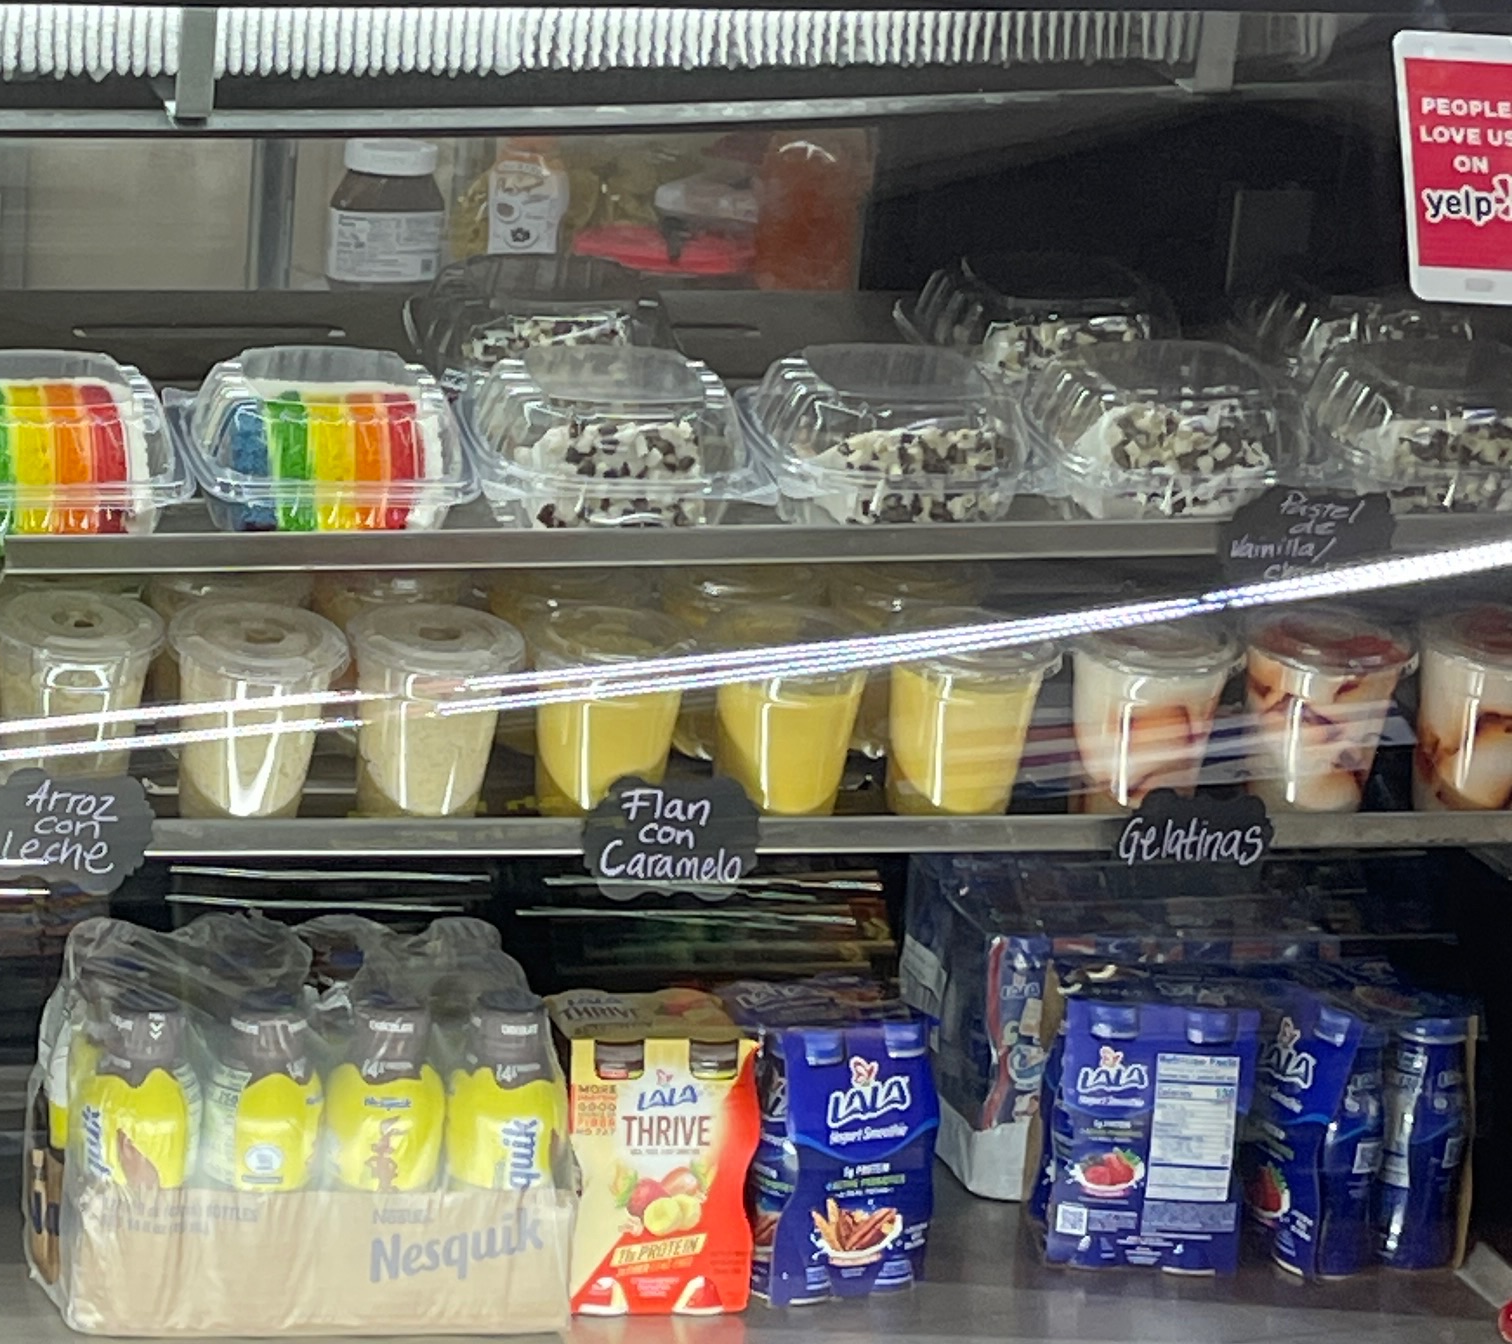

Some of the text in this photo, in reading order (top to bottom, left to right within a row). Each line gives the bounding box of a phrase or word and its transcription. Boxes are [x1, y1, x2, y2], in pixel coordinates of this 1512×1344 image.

[1421, 96, 1512, 119] PEOPLE
[1419, 125, 1512, 148] LOVE US
[1452, 155, 1489, 174] ON
[1426, 188, 1492, 222] yelp
[1280, 490, 1365, 524] Pastel
[1289, 518, 1337, 535] de
[25, 778, 118, 822] Arroz
[621, 788, 711, 826] Flan
[34, 815, 99, 839] con
[638, 822, 695, 849] con
[1118, 816, 1264, 866] Gelatinas
[599, 839, 741, 882] Caramelo
[637, 1084, 699, 1112] LALA
[827, 1076, 911, 1129] LALA
[622, 1115, 711, 1146] THRIVE
[369, 1207, 544, 1283] Nesquik
[637, 1237, 700, 1261] PROTEIN
